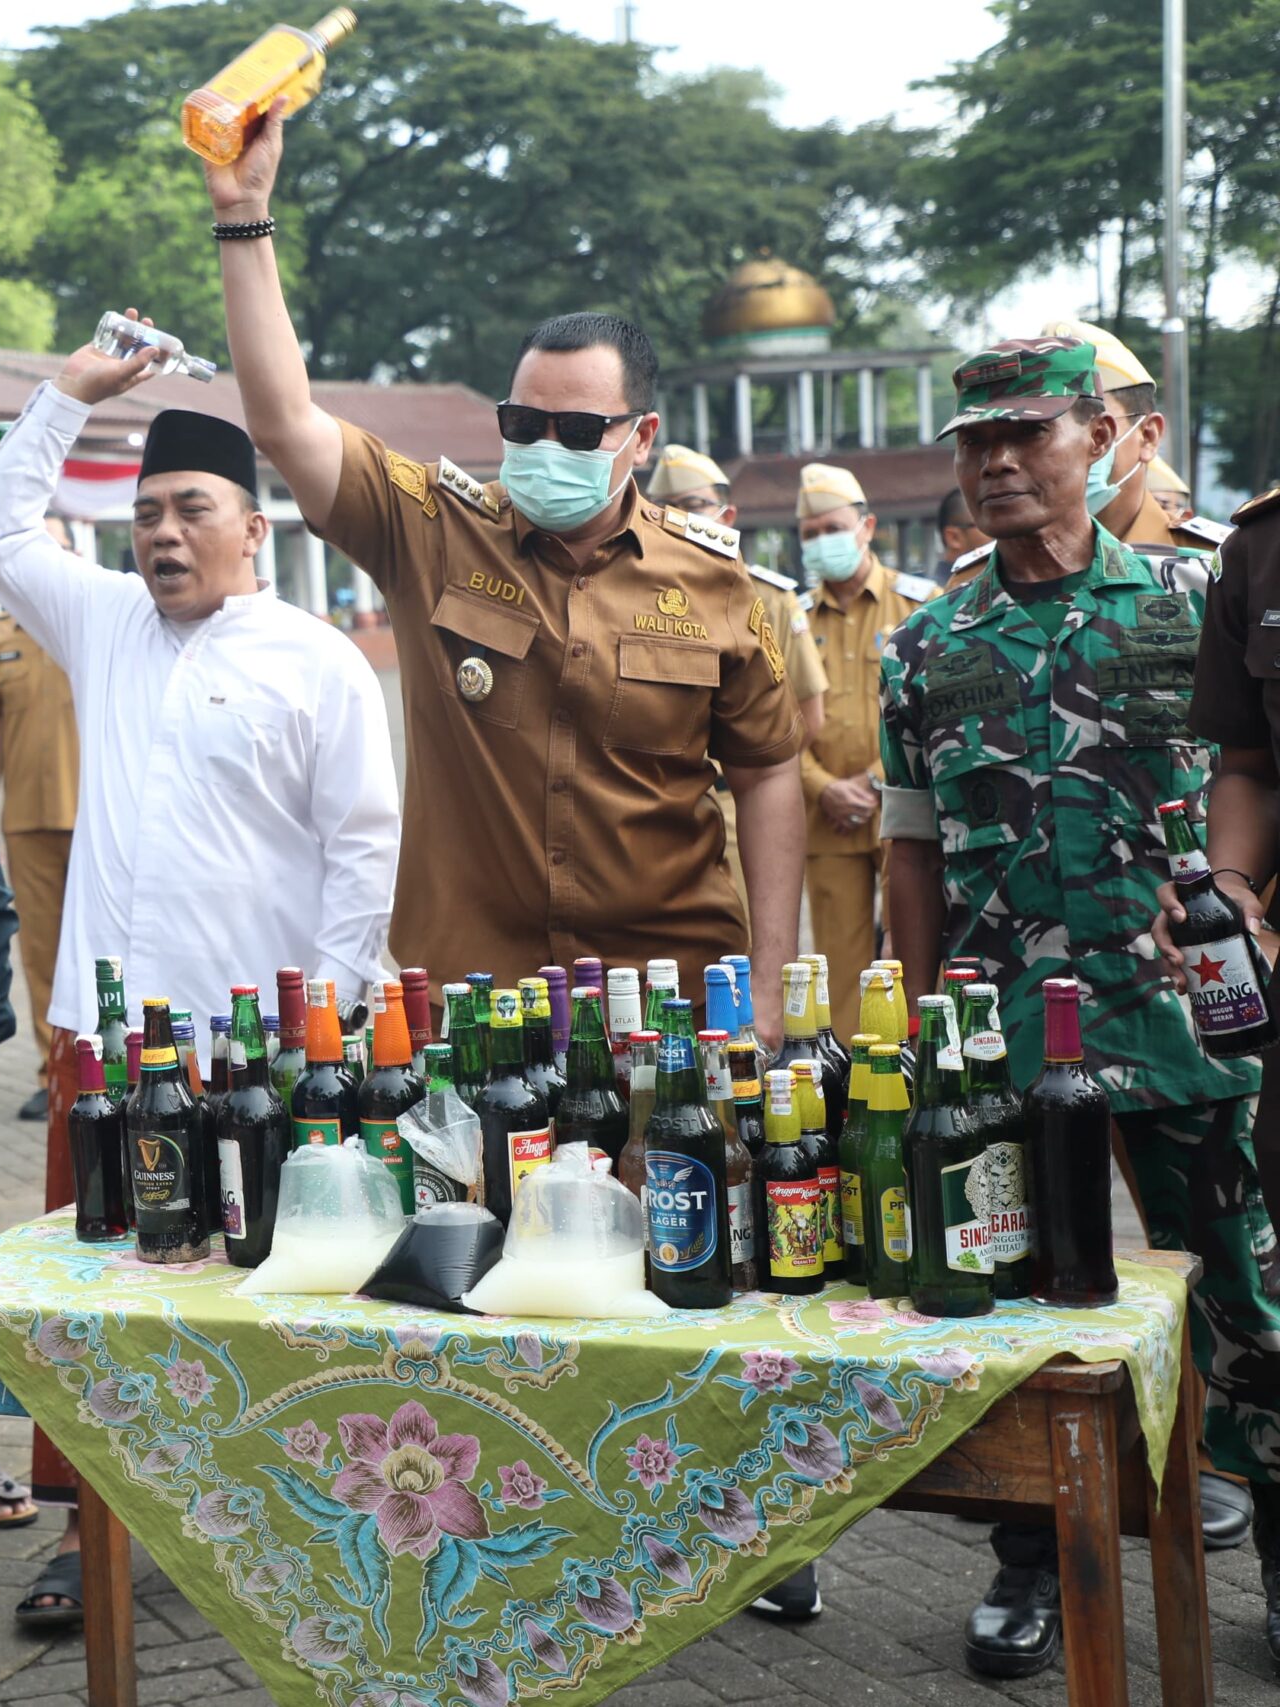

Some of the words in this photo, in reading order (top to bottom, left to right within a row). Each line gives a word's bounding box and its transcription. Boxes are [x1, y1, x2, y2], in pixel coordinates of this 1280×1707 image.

[469, 571, 526, 606] BUDI
[634, 613, 669, 633] WALI
[674, 618, 708, 640] KOTA
[1190, 981, 1253, 1006] BINTANG
[1212, 1013, 1235, 1022] MERAH
[134, 1169, 176, 1181] GUINNESS
[651, 1214, 687, 1227] LAGER
